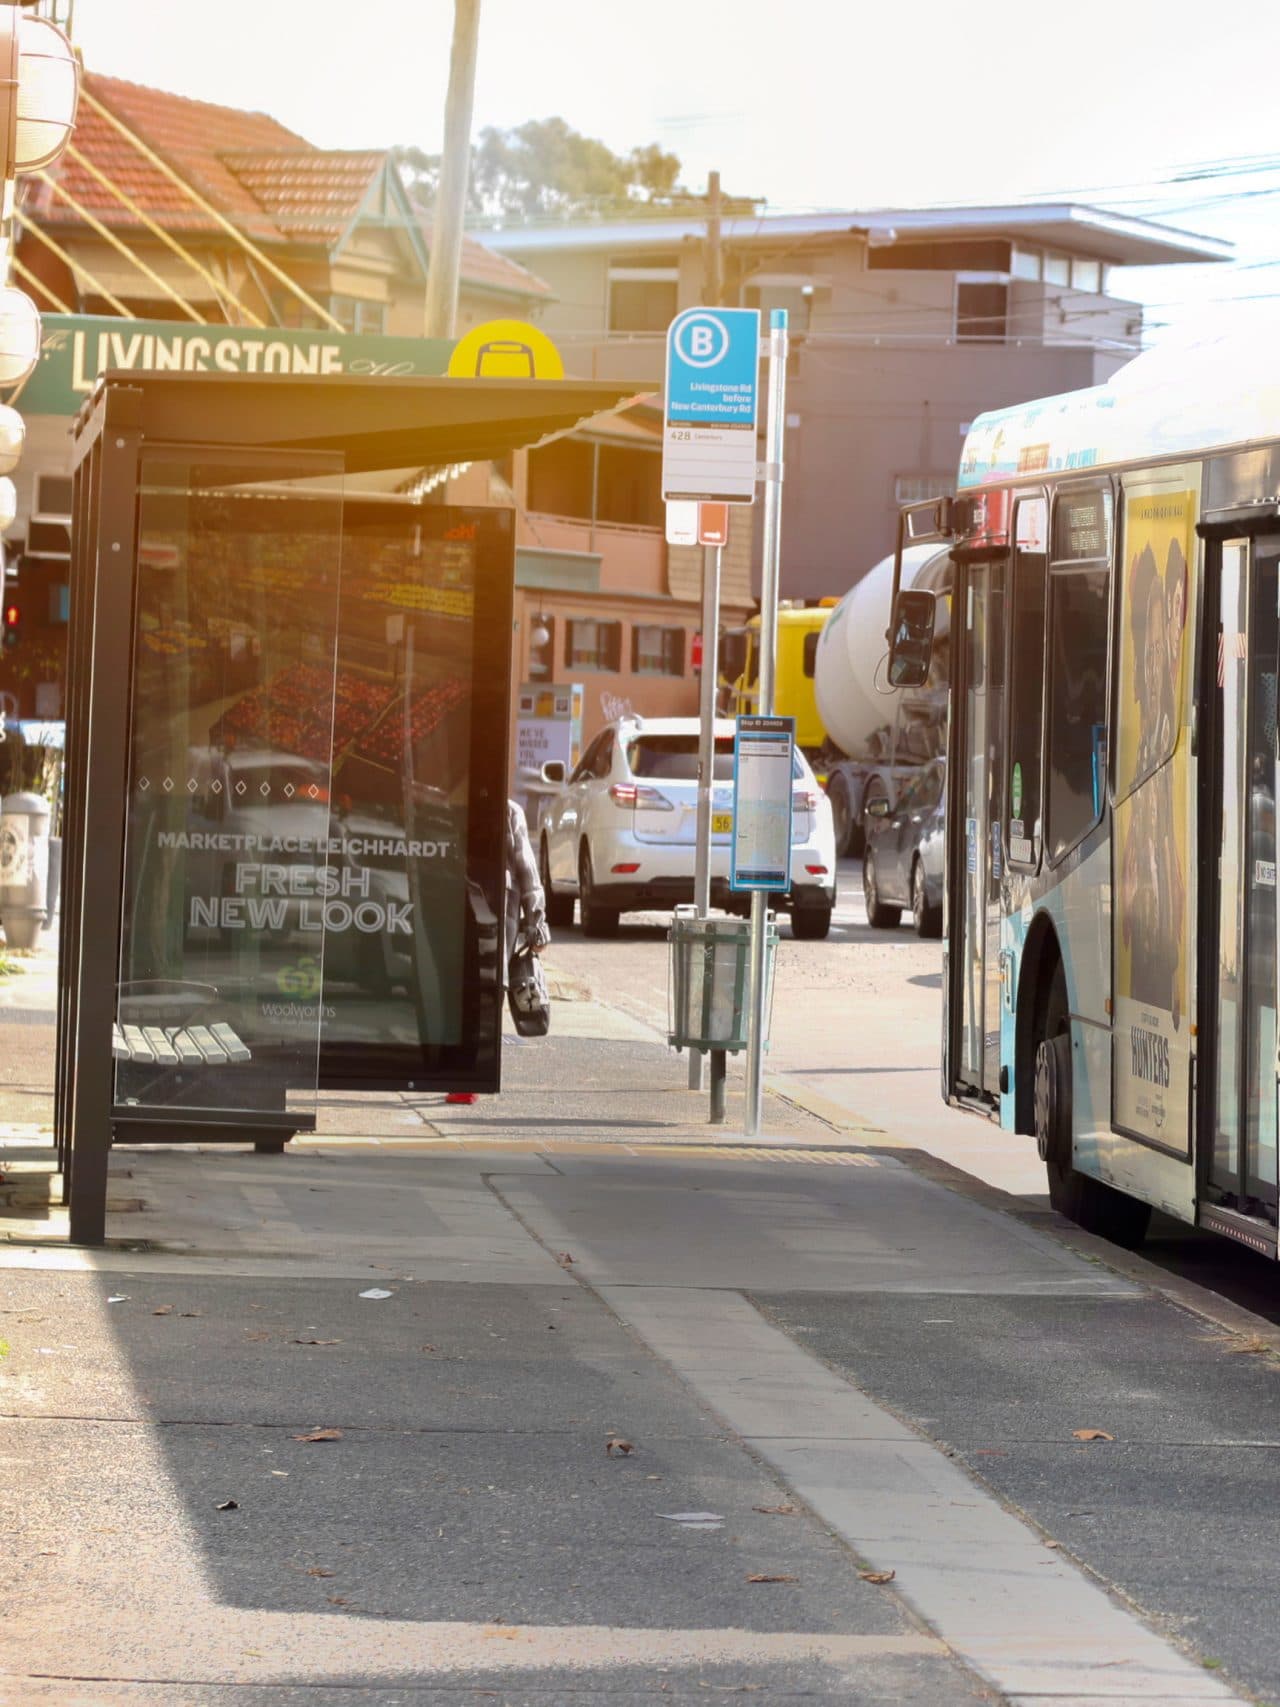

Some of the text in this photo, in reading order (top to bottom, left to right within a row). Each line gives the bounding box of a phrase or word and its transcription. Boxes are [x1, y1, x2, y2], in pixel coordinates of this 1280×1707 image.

[691, 326, 713, 356] B
[690, 382, 752, 394] Livingstone Rd
[723, 394, 752, 403] before
[671, 401, 689, 411] New
[690, 402, 738, 414] Canterbury
[671, 431, 691, 441] 428
[158, 831, 450, 859] MARKETPLACE LEICHHARDT
[235, 863, 370, 898] FRESH
[189, 896, 415, 935] NEW LOOK
[1131, 1024, 1170, 1088] HUNTERS
